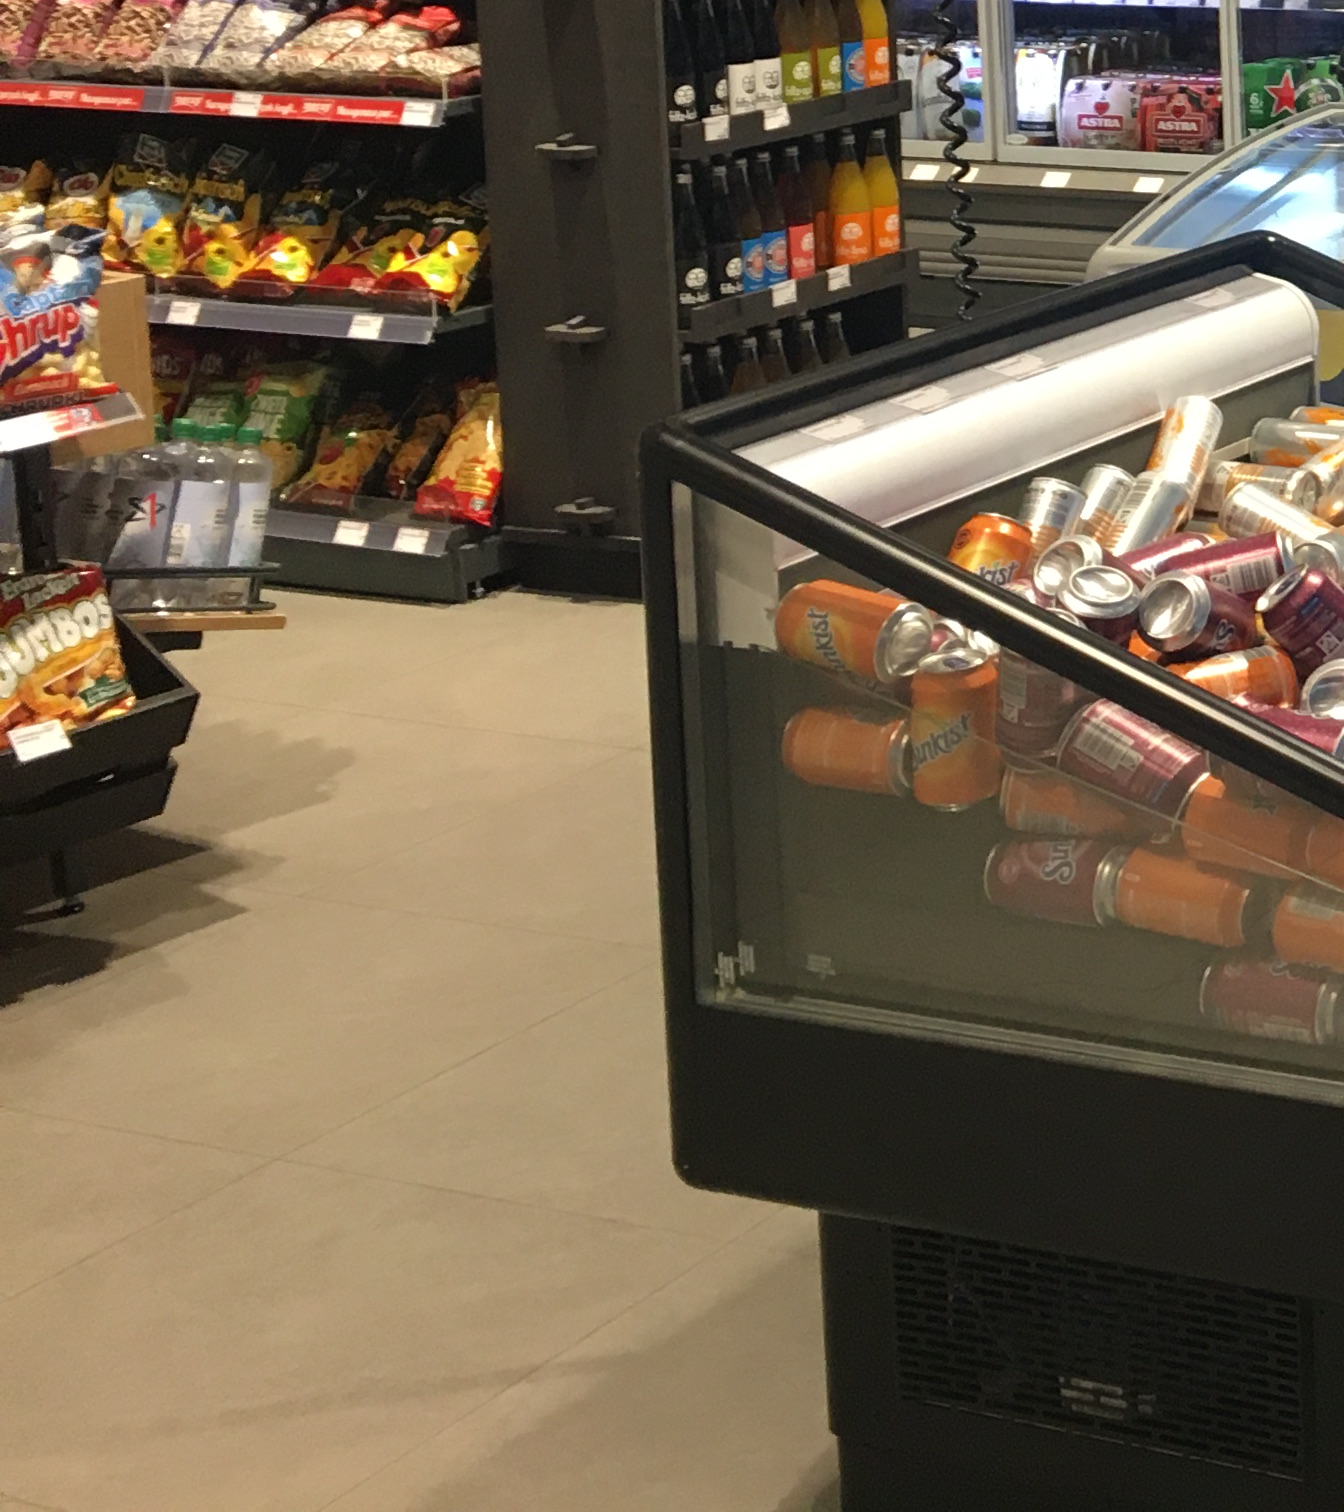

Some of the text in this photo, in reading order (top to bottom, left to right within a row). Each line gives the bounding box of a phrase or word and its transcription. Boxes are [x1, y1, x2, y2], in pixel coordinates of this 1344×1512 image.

[1079, 117, 1122, 129] ASTRA
[1156, 120, 1198, 132] ASTRA
[913, 712, 972, 771] unkist
